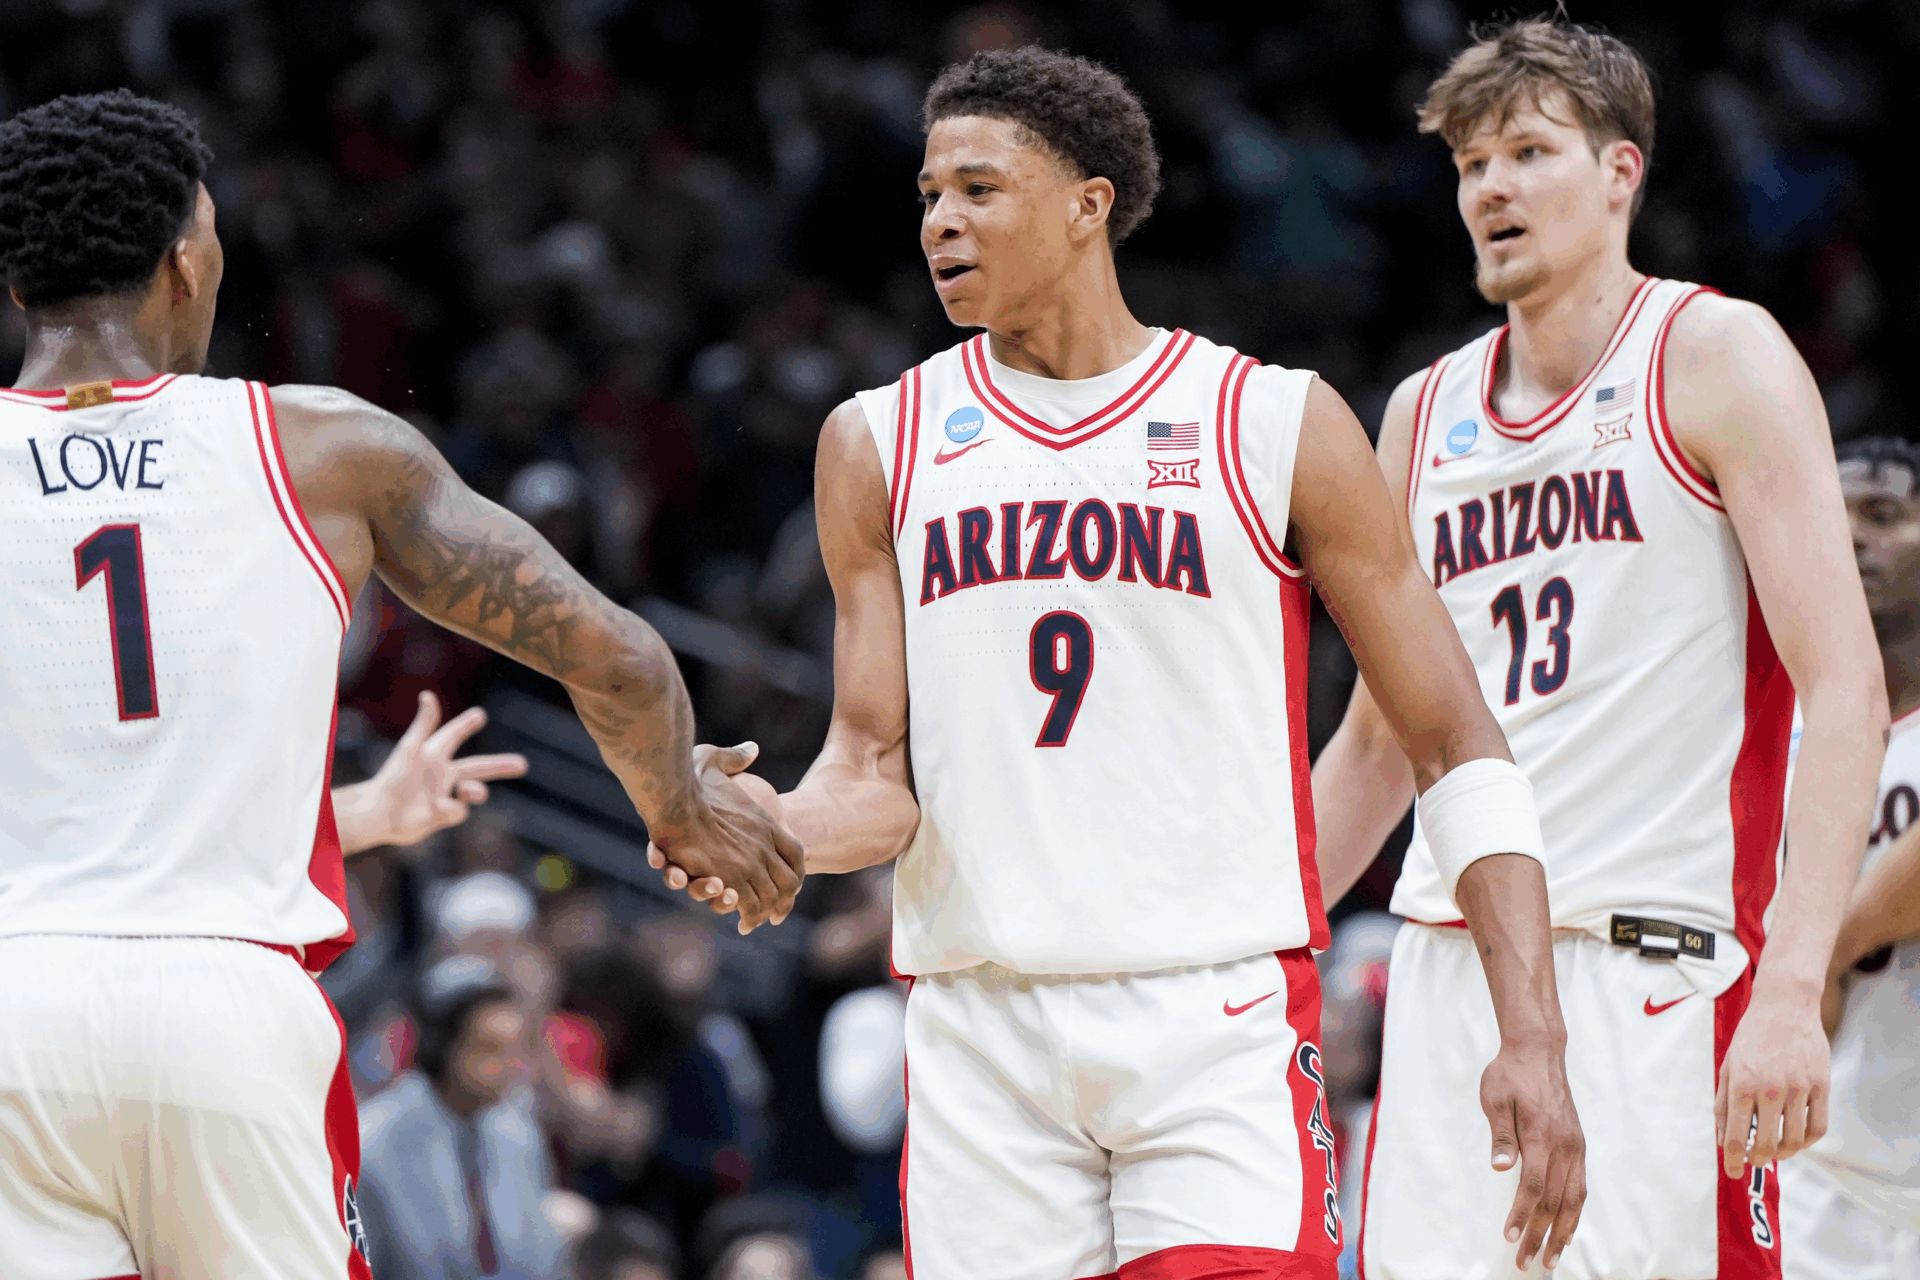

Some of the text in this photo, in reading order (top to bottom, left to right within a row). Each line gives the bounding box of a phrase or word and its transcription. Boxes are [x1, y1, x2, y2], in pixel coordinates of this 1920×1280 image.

[28, 433, 164, 496] LOVE
[1150, 461, 1198, 486] XII
[920, 498, 1211, 607] ARIZONA
[1433, 469, 1644, 590] ARIZONA
[73, 523, 159, 721] 1
[1029, 610, 1094, 748] 9
[1490, 576, 1574, 706] 13
